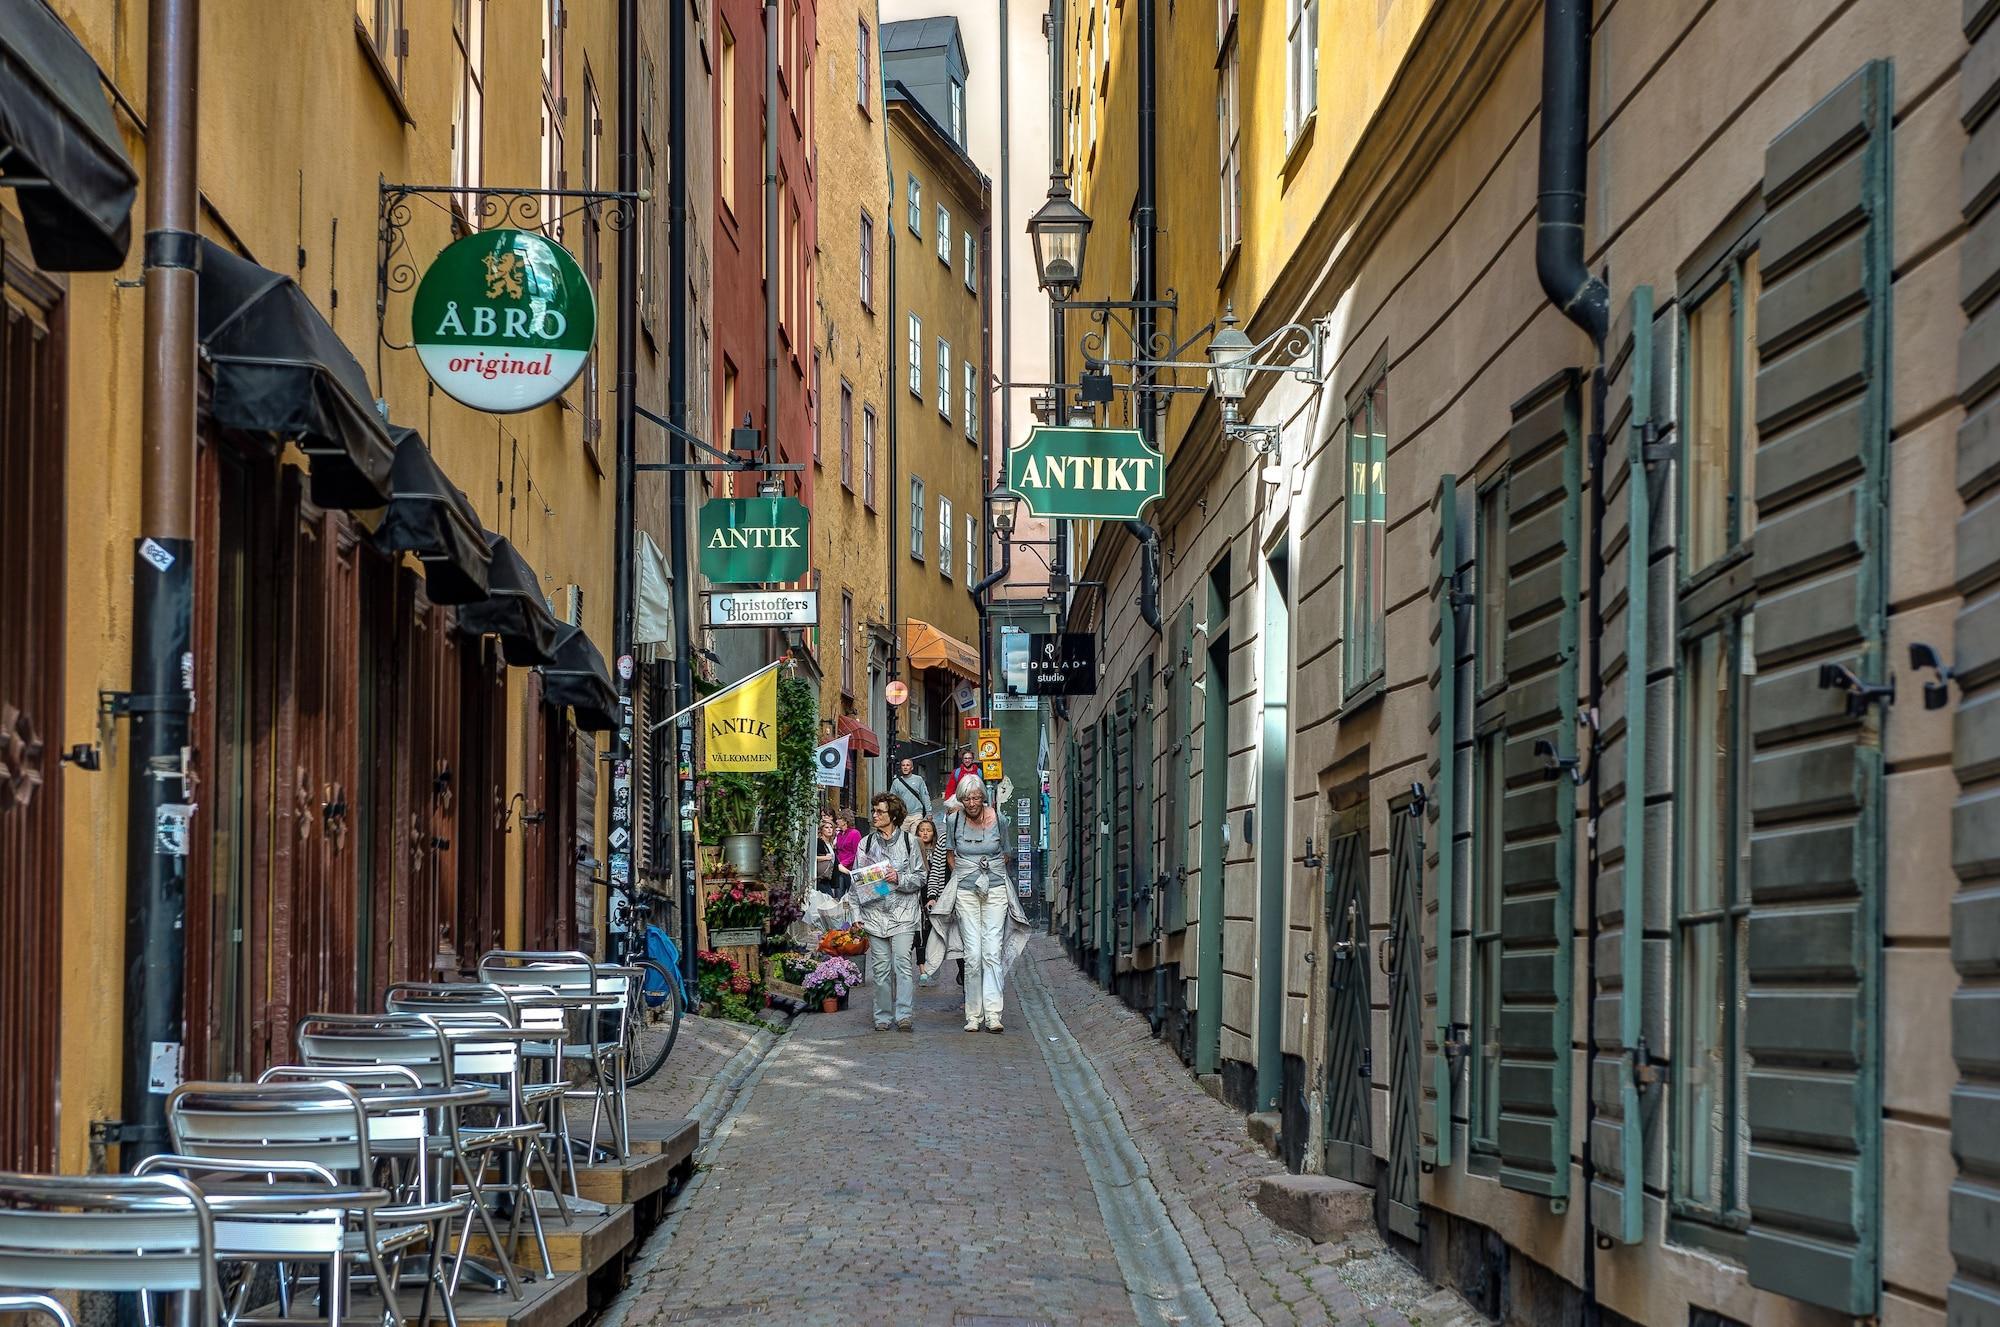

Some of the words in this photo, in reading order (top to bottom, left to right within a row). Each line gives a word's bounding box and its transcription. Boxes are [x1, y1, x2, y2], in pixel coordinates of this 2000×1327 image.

[436, 301, 567, 340] ÅBRO
[449, 351, 552, 380] original
[1019, 454, 1154, 491] ANTIKT
[707, 527, 801, 549] ANTIK
[719, 597, 808, 612] Christoffers
[726, 608, 793, 622] Blommor
[1037, 672, 1065, 682] studio
[711, 717, 771, 739] ANTIK
[712, 752, 772, 763] VÄLKOMMEN
